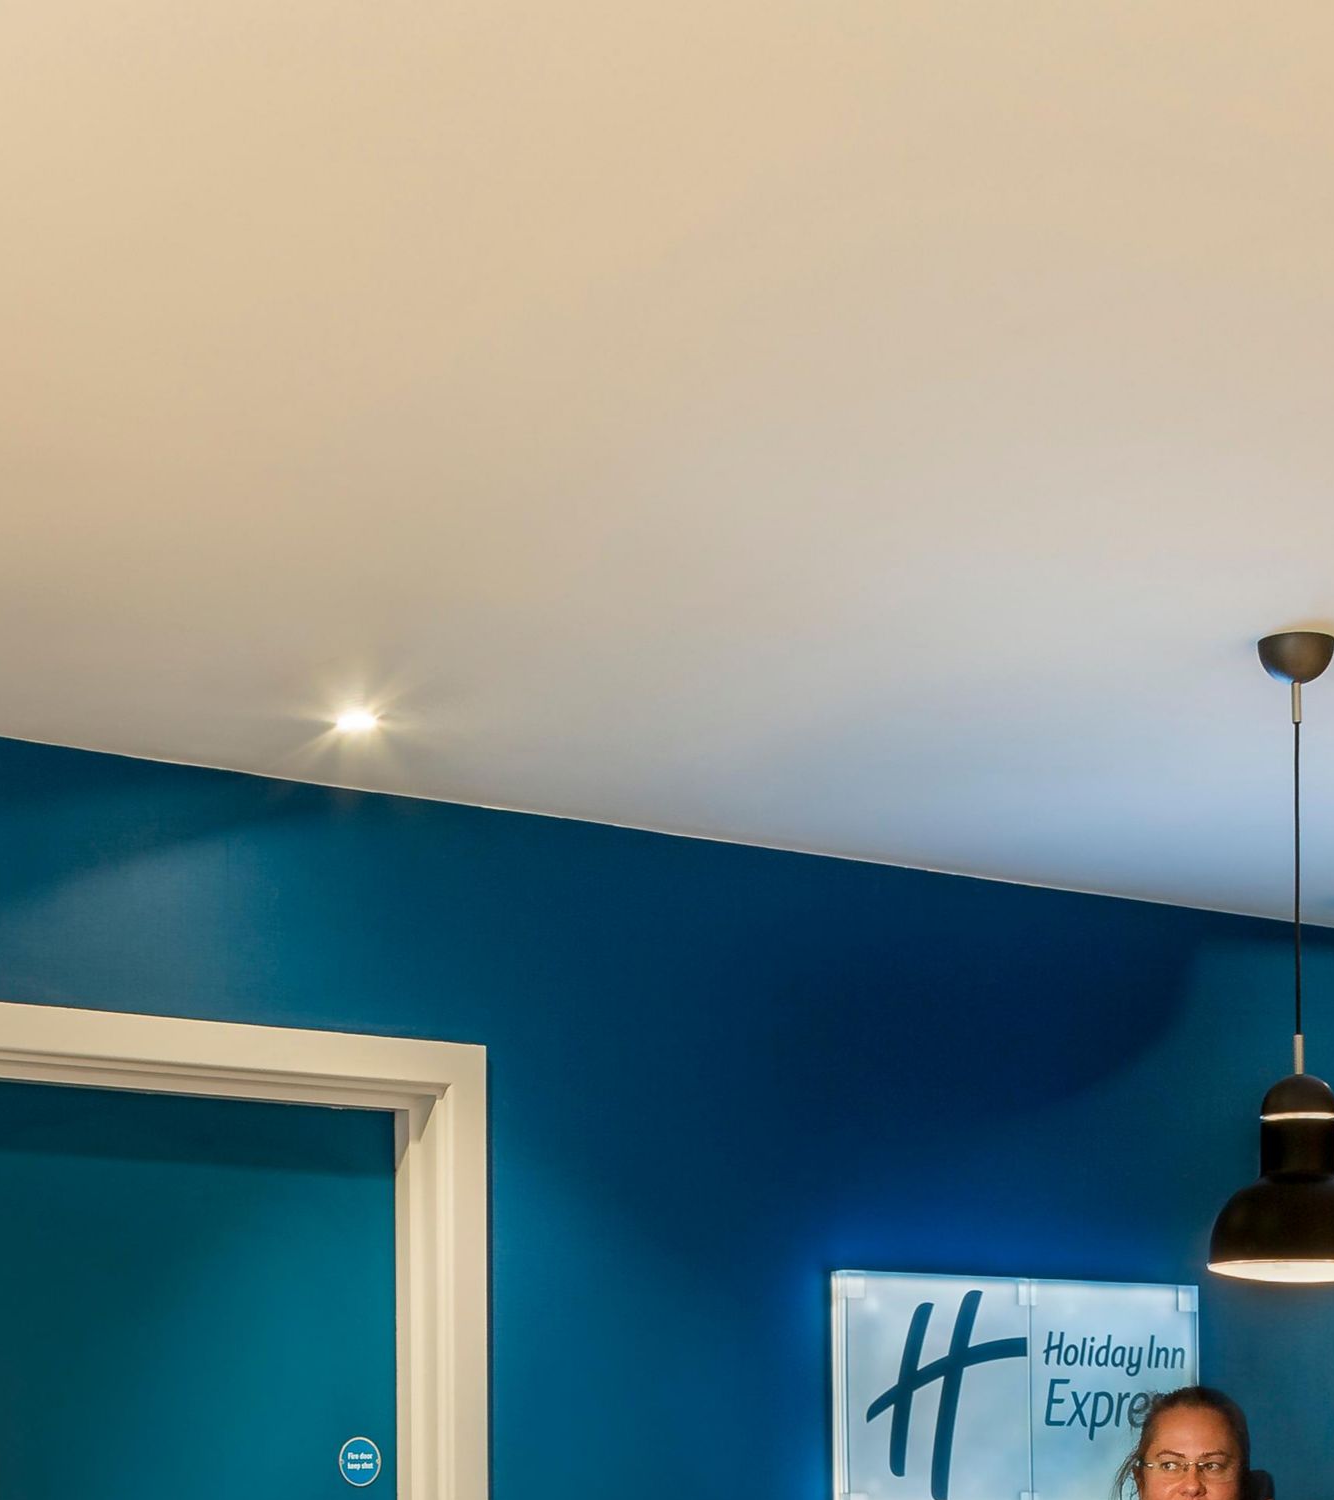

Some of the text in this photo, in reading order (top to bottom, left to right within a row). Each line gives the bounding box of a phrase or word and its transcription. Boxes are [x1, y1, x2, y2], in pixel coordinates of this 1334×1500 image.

[1043, 1331, 1185, 1377] Holiday Inn
[1044, 1379, 1163, 1441] Expre
